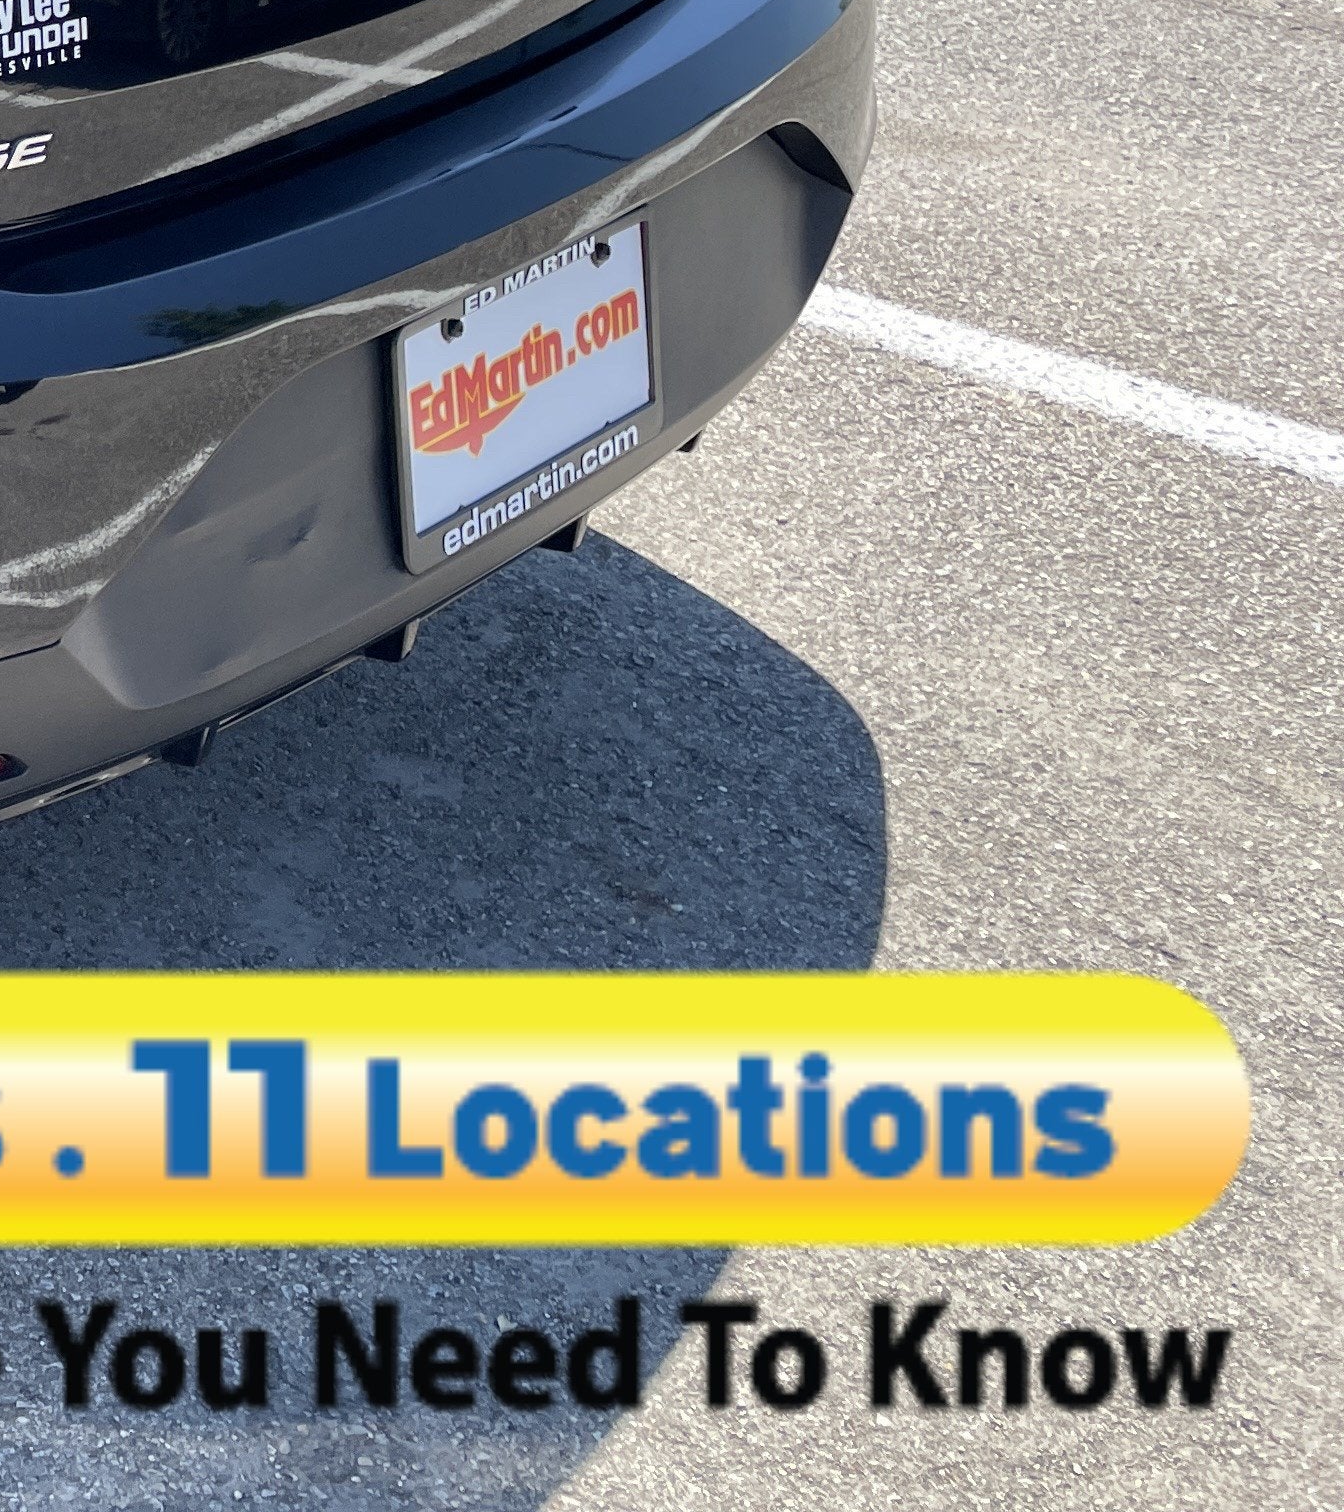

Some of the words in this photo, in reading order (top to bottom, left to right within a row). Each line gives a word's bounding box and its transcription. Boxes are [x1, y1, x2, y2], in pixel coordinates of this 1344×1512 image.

[462, 285, 496, 315] ED
[502, 236, 596, 294] MARTIN
[442, 423, 639, 557] edmartin.com
